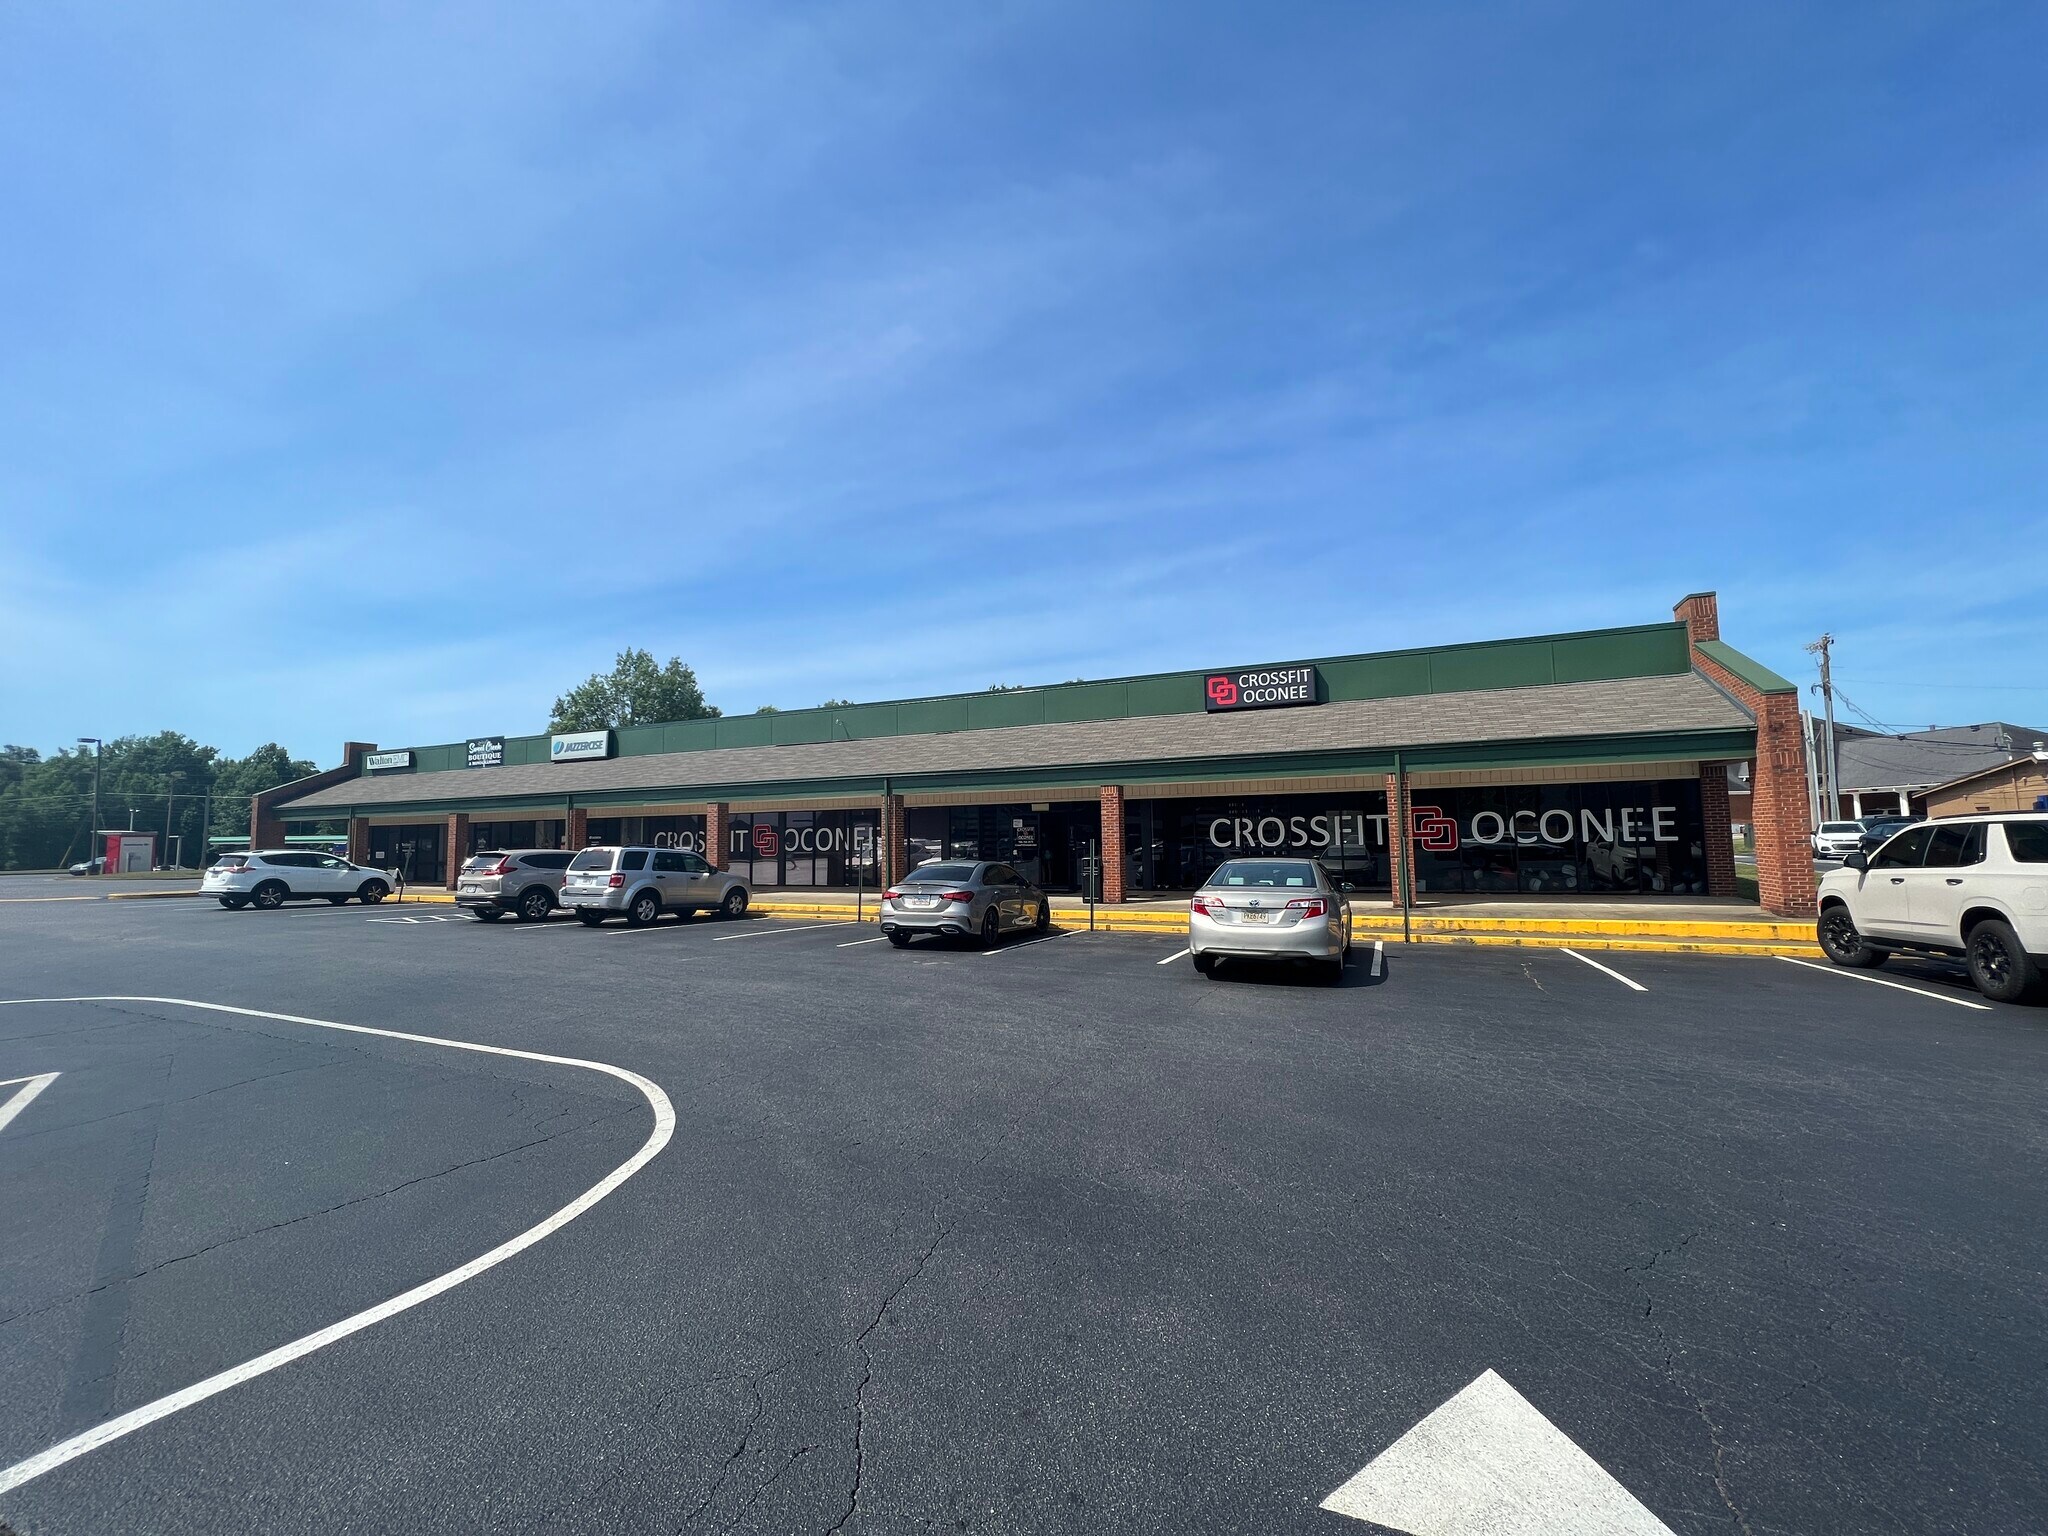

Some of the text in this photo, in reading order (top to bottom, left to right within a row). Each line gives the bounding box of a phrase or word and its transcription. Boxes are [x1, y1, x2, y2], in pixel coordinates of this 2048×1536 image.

[1238, 668, 1311, 688] CROSSFIT
[1243, 685, 1308, 703] OCONEE
[369, 755, 393, 766] Walton
[468, 752, 502, 761] BOUTIQUE
[1209, 806, 1679, 848] CROSSFIT OCONEE
[654, 829, 749, 853] CROSIT
